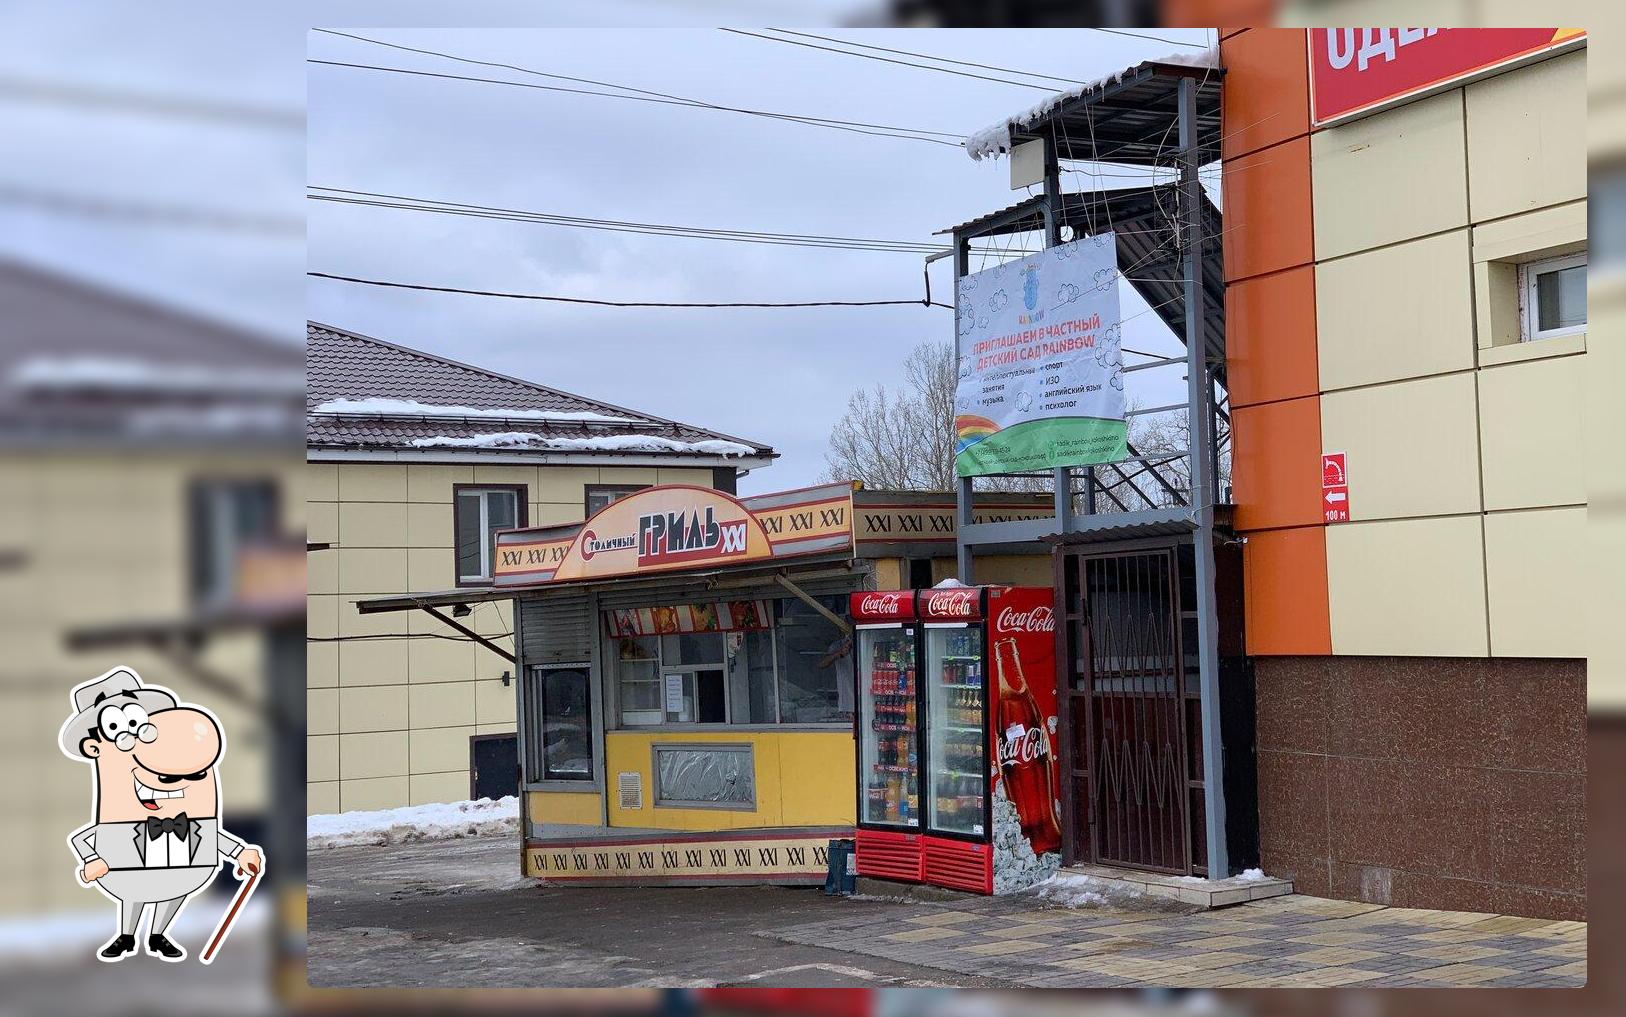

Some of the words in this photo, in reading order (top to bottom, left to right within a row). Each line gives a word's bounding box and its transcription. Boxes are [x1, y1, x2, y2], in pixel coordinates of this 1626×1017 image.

[973, 329, 1037, 355] ПРИГЛАШАЕМ
[1038, 327, 1044, 340] В
[1046, 313, 1100, 337] ЧАСТНЫЙ
[976, 347, 1018, 372] ДЕТСКИЙ
[1020, 345, 1041, 361] САД
[1043, 334, 1095, 355] RAINBOW
[1045, 361, 1063, 371] спорт
[1045, 375, 1060, 385] ИЗО
[982, 384, 1005, 394] занятия
[1045, 385, 1085, 398] английский
[1086, 384, 1103, 392] язык
[982, 396, 1005, 407] музыка
[1045, 400, 1077, 410] психолог
[1325, 510, 1338, 521] 100
[638, 504, 721, 557] ГРИЛЬ
[997, 606, 1056, 633] Coca-Cola
